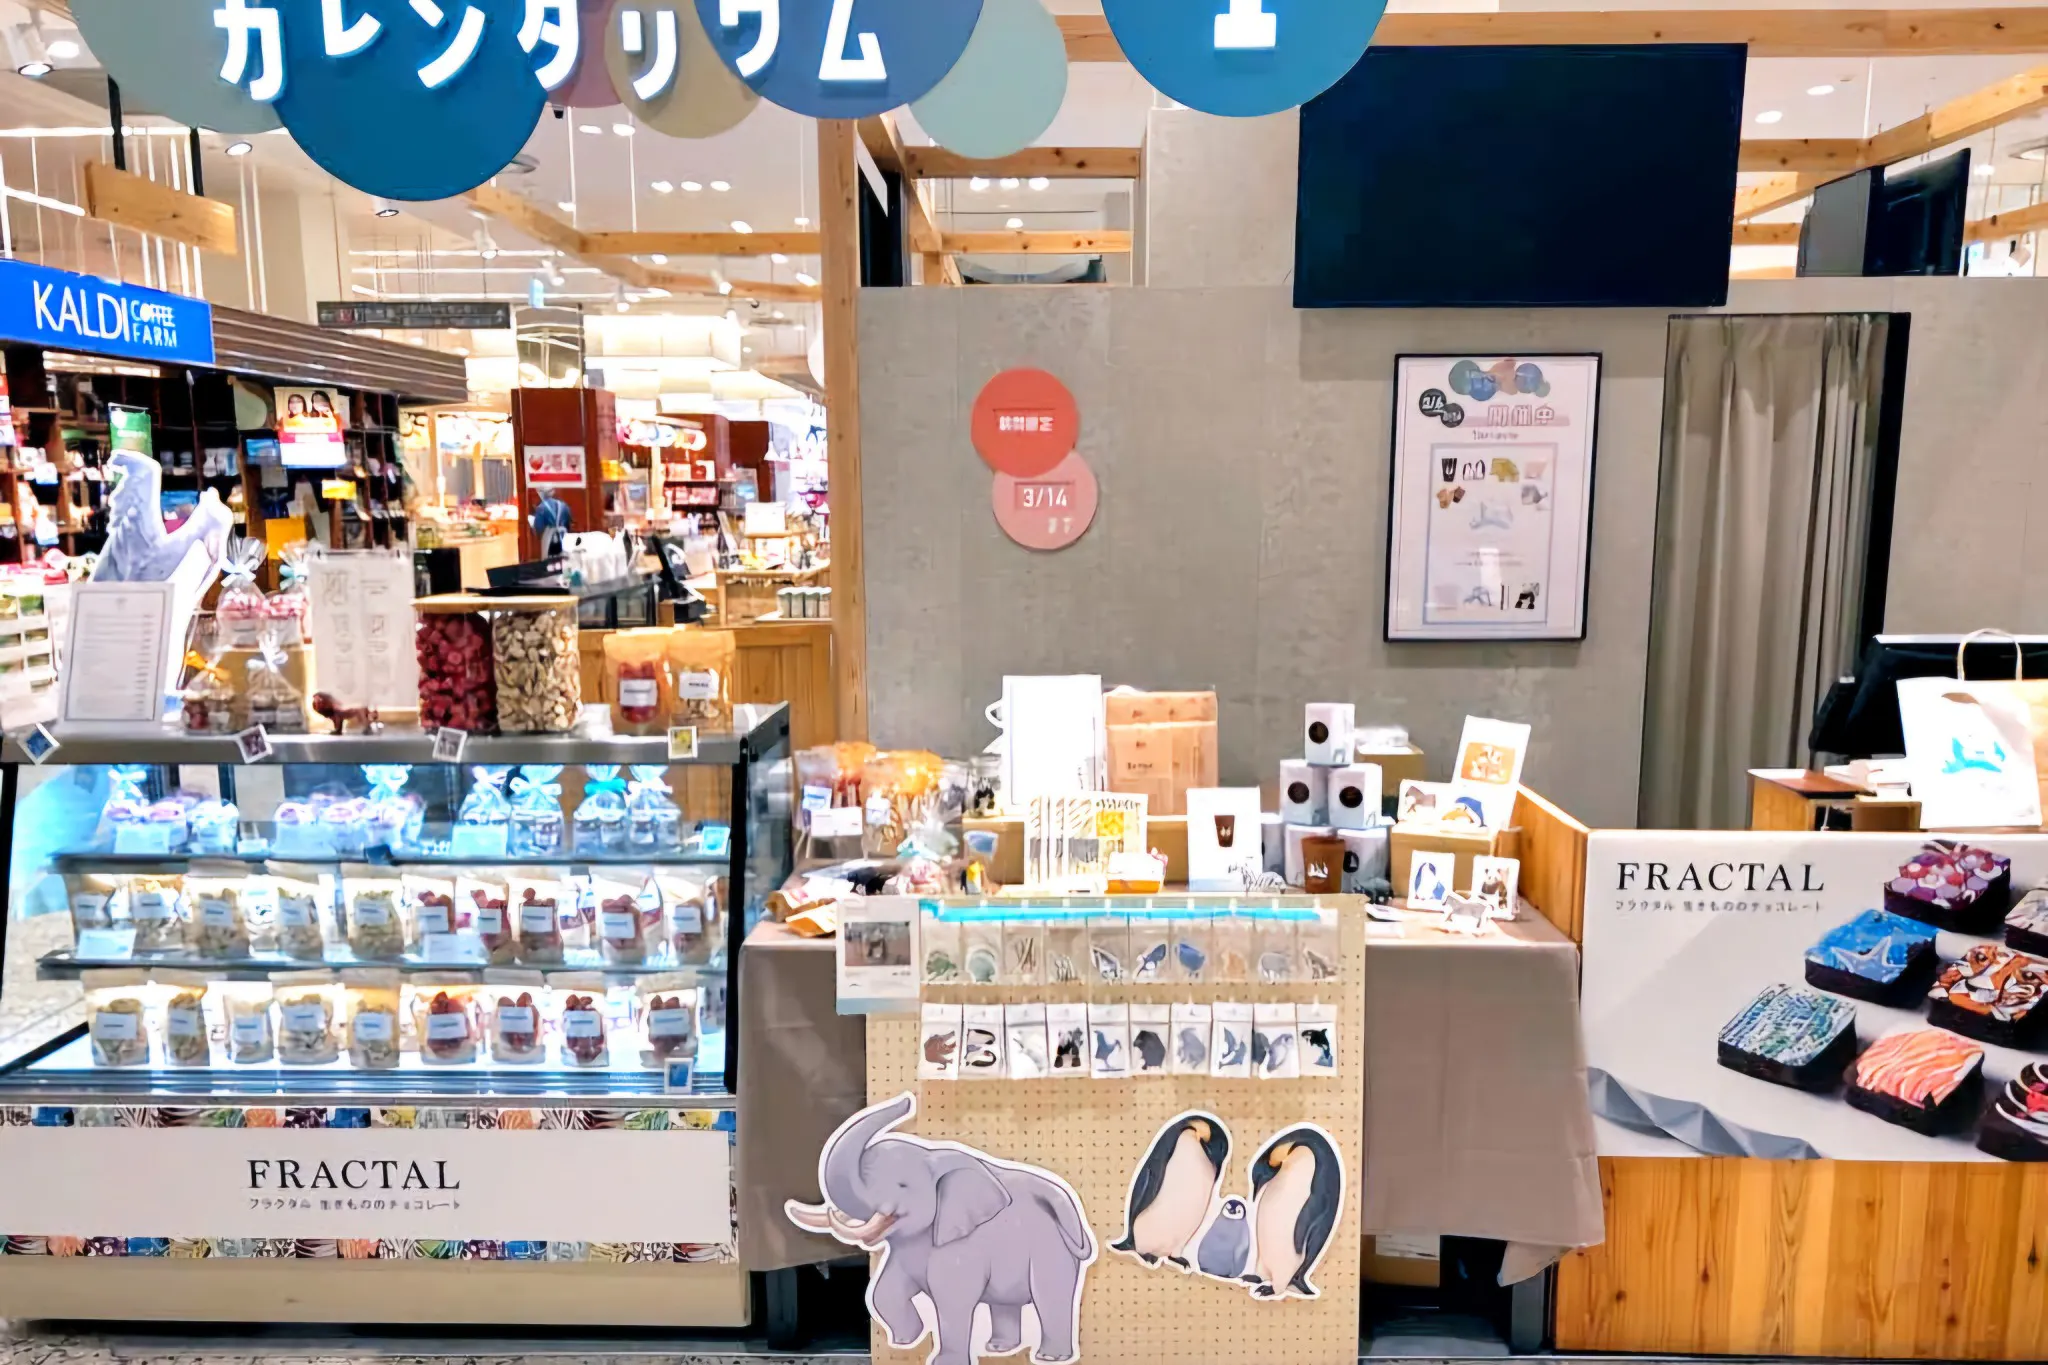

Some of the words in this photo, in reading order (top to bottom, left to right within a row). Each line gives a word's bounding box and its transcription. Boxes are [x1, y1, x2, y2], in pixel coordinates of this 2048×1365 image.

[33, 280, 131, 342] KALDI
[130, 300, 176, 327] COFFEE
[132, 323, 178, 348] FARM
[1023, 487, 1067, 507] 3/14
[1616, 862, 1825, 891] FRACTAL
[247, 1159, 461, 1189] FRACTAL
